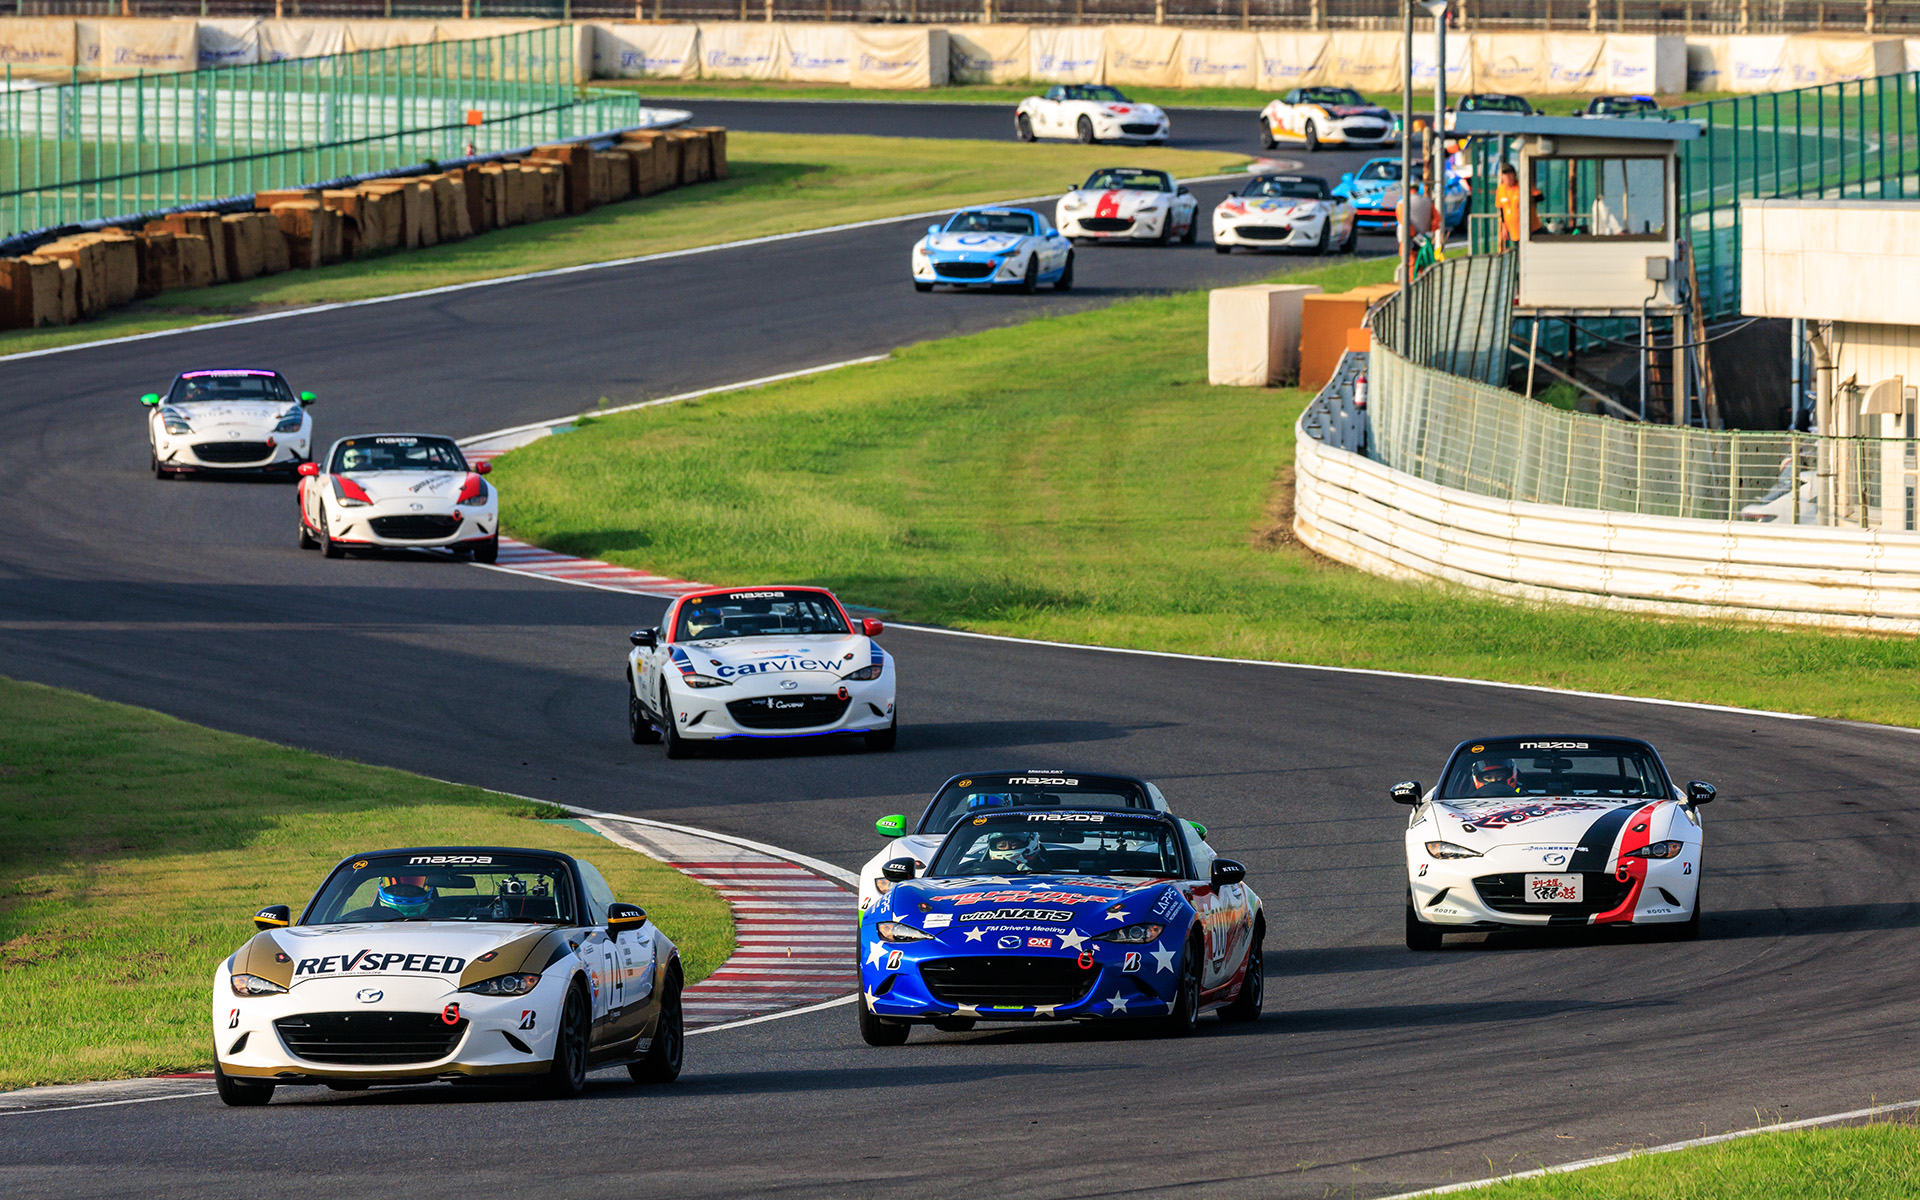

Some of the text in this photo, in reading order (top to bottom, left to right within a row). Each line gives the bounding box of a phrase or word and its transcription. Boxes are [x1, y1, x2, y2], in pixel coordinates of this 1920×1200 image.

[730, 591, 785, 600] mazda
[716, 657, 842, 677] carview
[1519, 741, 1589, 750] mazda
[1008, 777, 1079, 786] mazda
[1027, 814, 1105, 823] mazda
[409, 856, 493, 865] mazda
[1152, 887, 1178, 915] LAPPS
[260, 911, 277, 919] KTEL
[960, 911, 995, 921] with
[993, 908, 1075, 922] NATS
[1032, 926, 1066, 934] Meeting
[1028, 938, 1051, 946] OK!
[295, 949, 466, 976] REVSPEED
[605, 950, 623, 1006] 74
